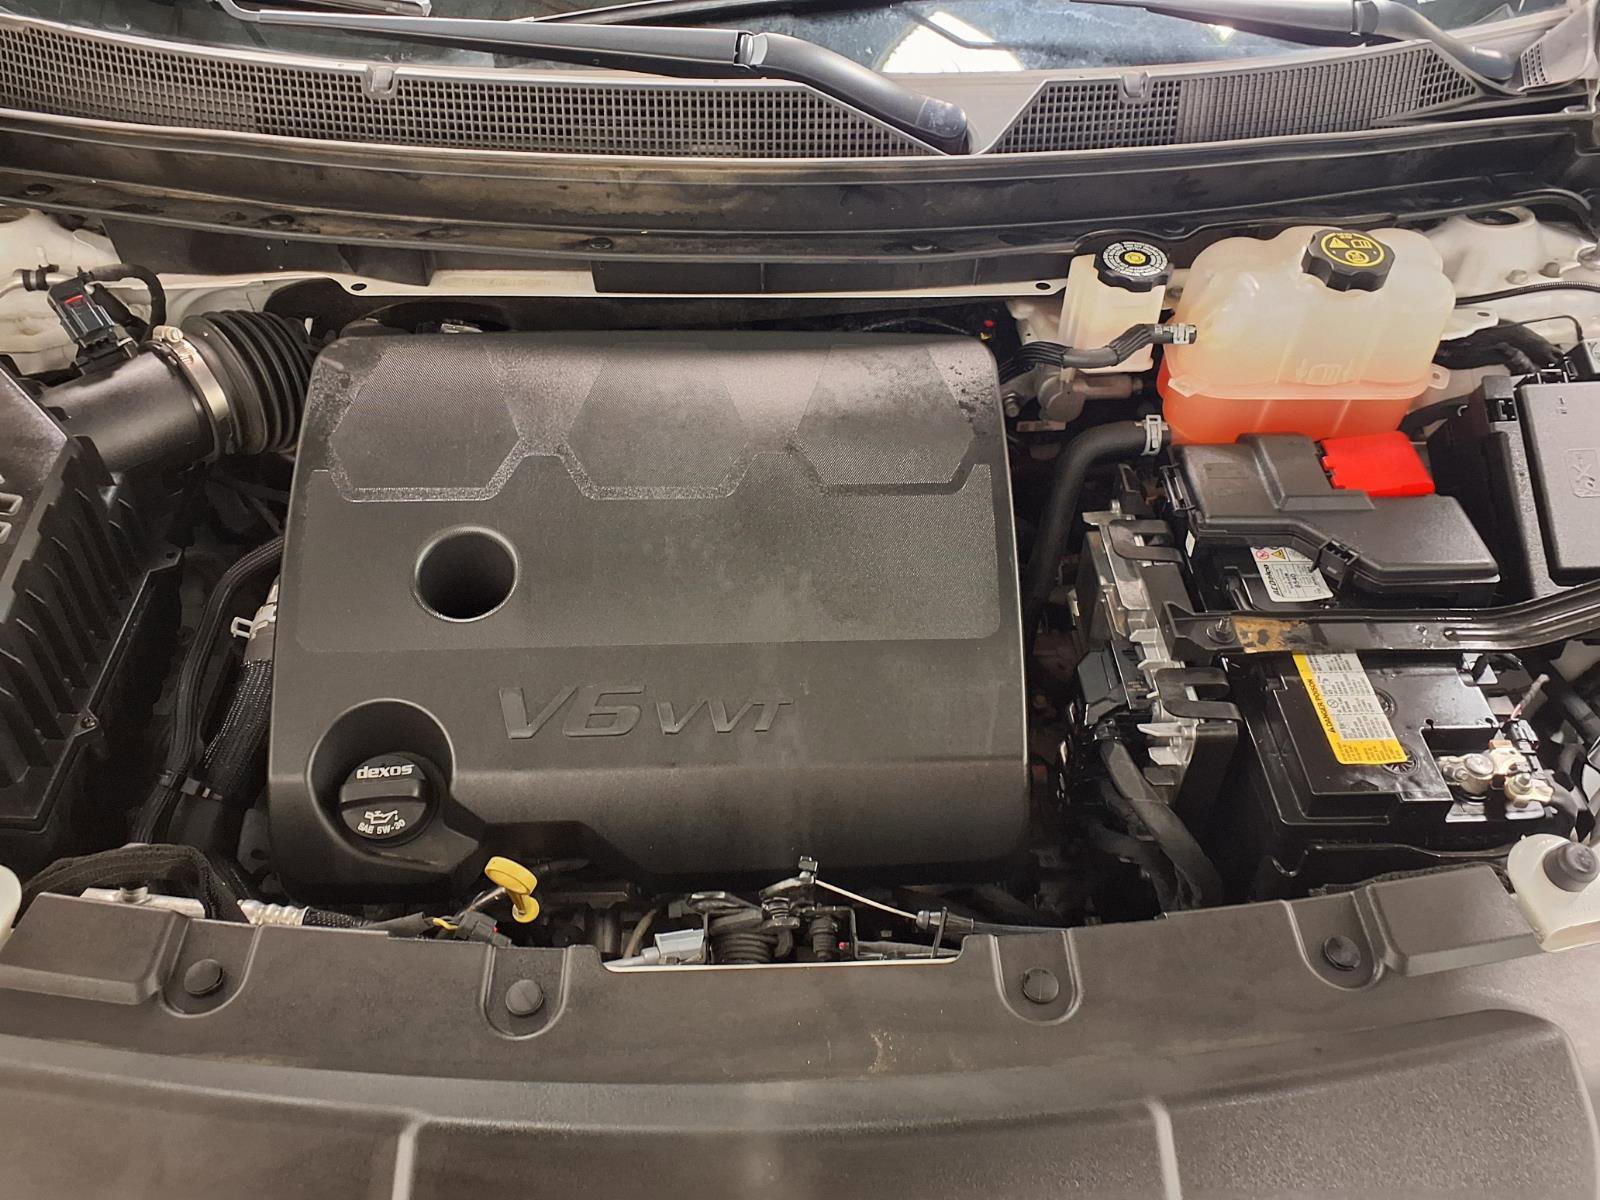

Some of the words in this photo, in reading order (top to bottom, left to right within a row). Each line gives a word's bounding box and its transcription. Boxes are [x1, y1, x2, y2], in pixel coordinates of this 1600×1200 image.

[1307, 678, 1322, 701] POISON
[498, 684, 646, 739] V6
[656, 696, 794, 734] VVT
[1317, 702, 1333, 727] DANGER
[356, 764, 415, 779] dexos
[357, 822, 375, 834] SAE
[376, 819, 406, 834] 5W-30
